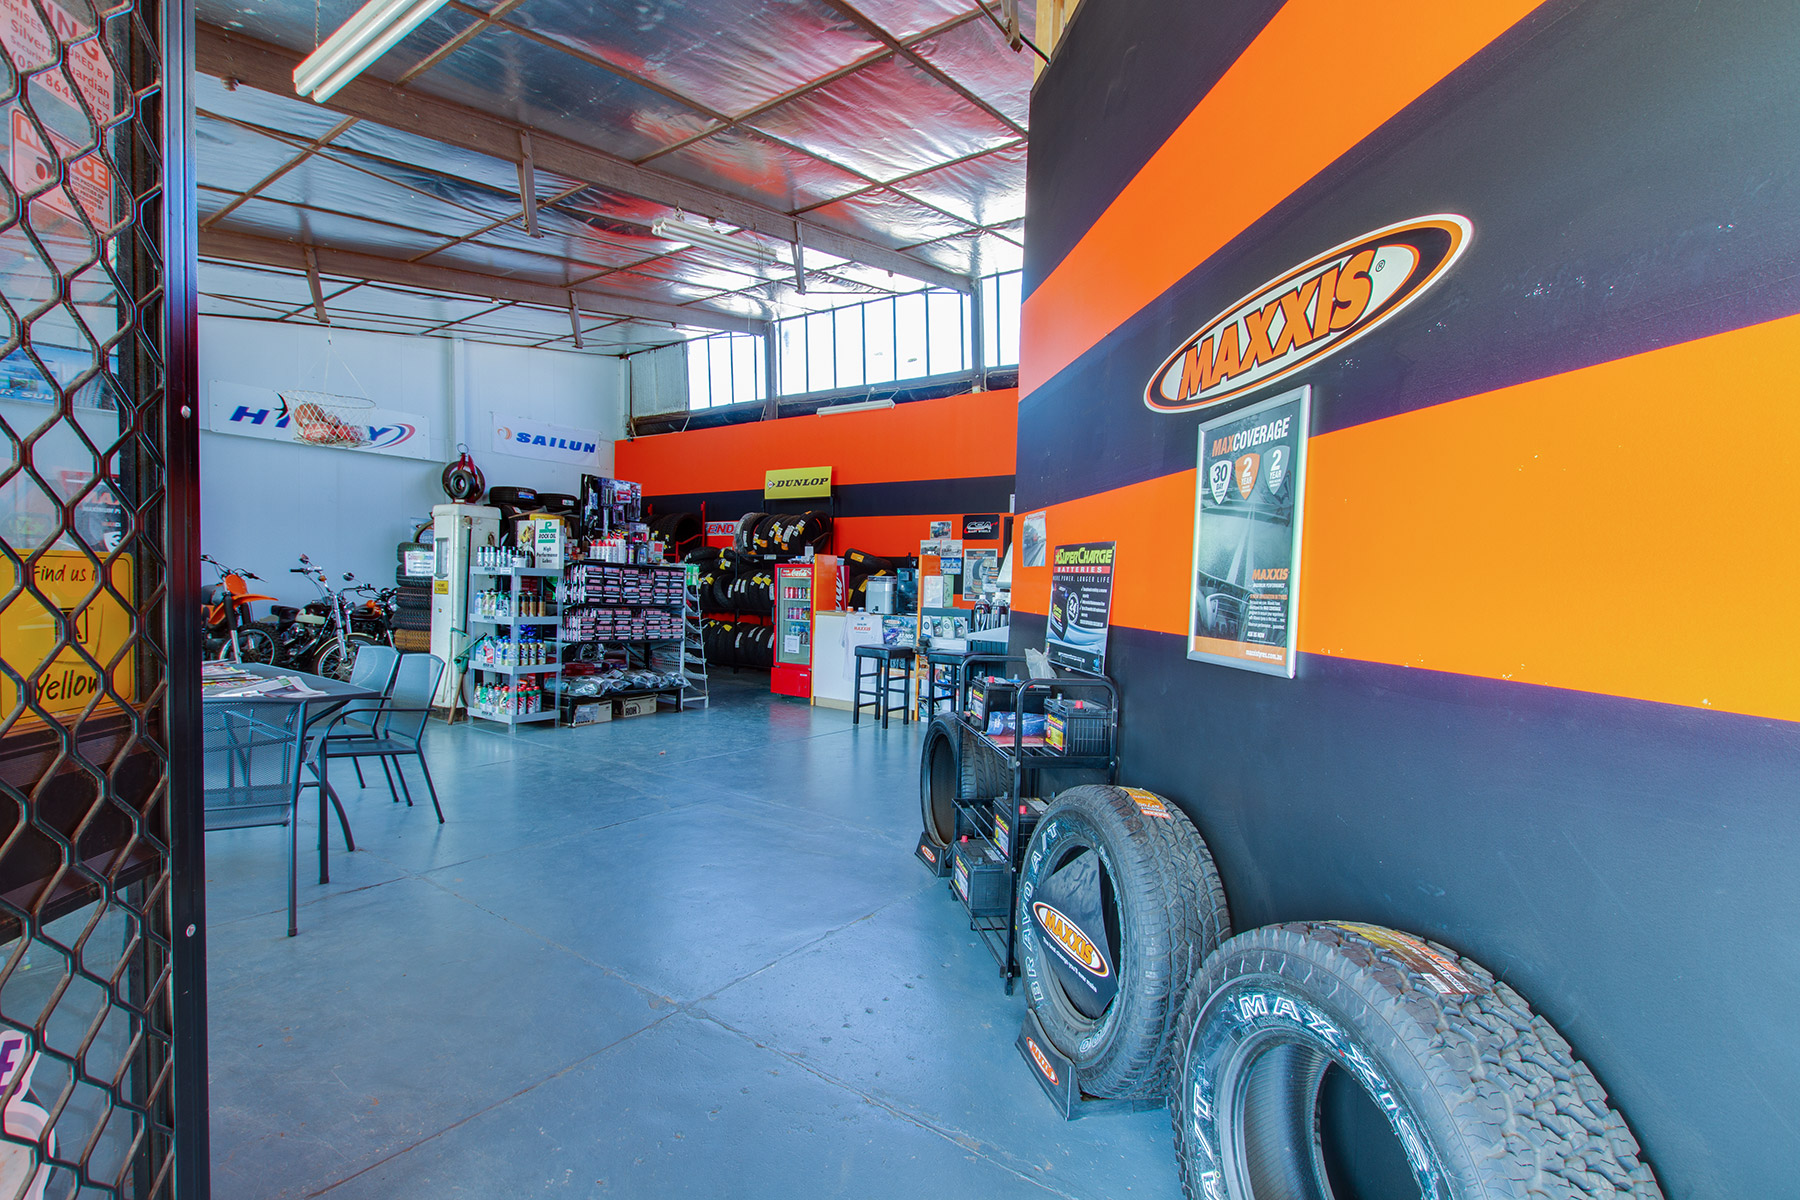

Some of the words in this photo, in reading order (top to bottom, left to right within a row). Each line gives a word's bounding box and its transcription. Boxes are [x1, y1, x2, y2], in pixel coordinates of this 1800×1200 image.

[0, 0, 43, 33] EMISES
[97, 68, 109, 82] BY
[71, 66, 110, 99] uardian
[20, 118, 106, 188] NTCE
[1176, 250, 1378, 401] MAXXIS
[516, 431, 596, 454] SAILUN
[1212, 416, 1291, 457] MAXCOVERAGE
[1242, 457, 1252, 477] 2
[1270, 449, 1282, 471] 2
[775, 476, 829, 489] DUNLOP
[1214, 463, 1228, 484] 30
[1241, 476, 1252, 486] YEAR
[1270, 470, 1281, 479] YEAR
[33, 564, 66, 582] Find
[71, 568, 87, 582] us
[1252, 568, 1289, 581] MAXXIS
[625, 706, 637, 716] ROH
[1045, 909, 1093, 965] MAXXIS
[1032, 1044, 1054, 1077] MAXXIS
